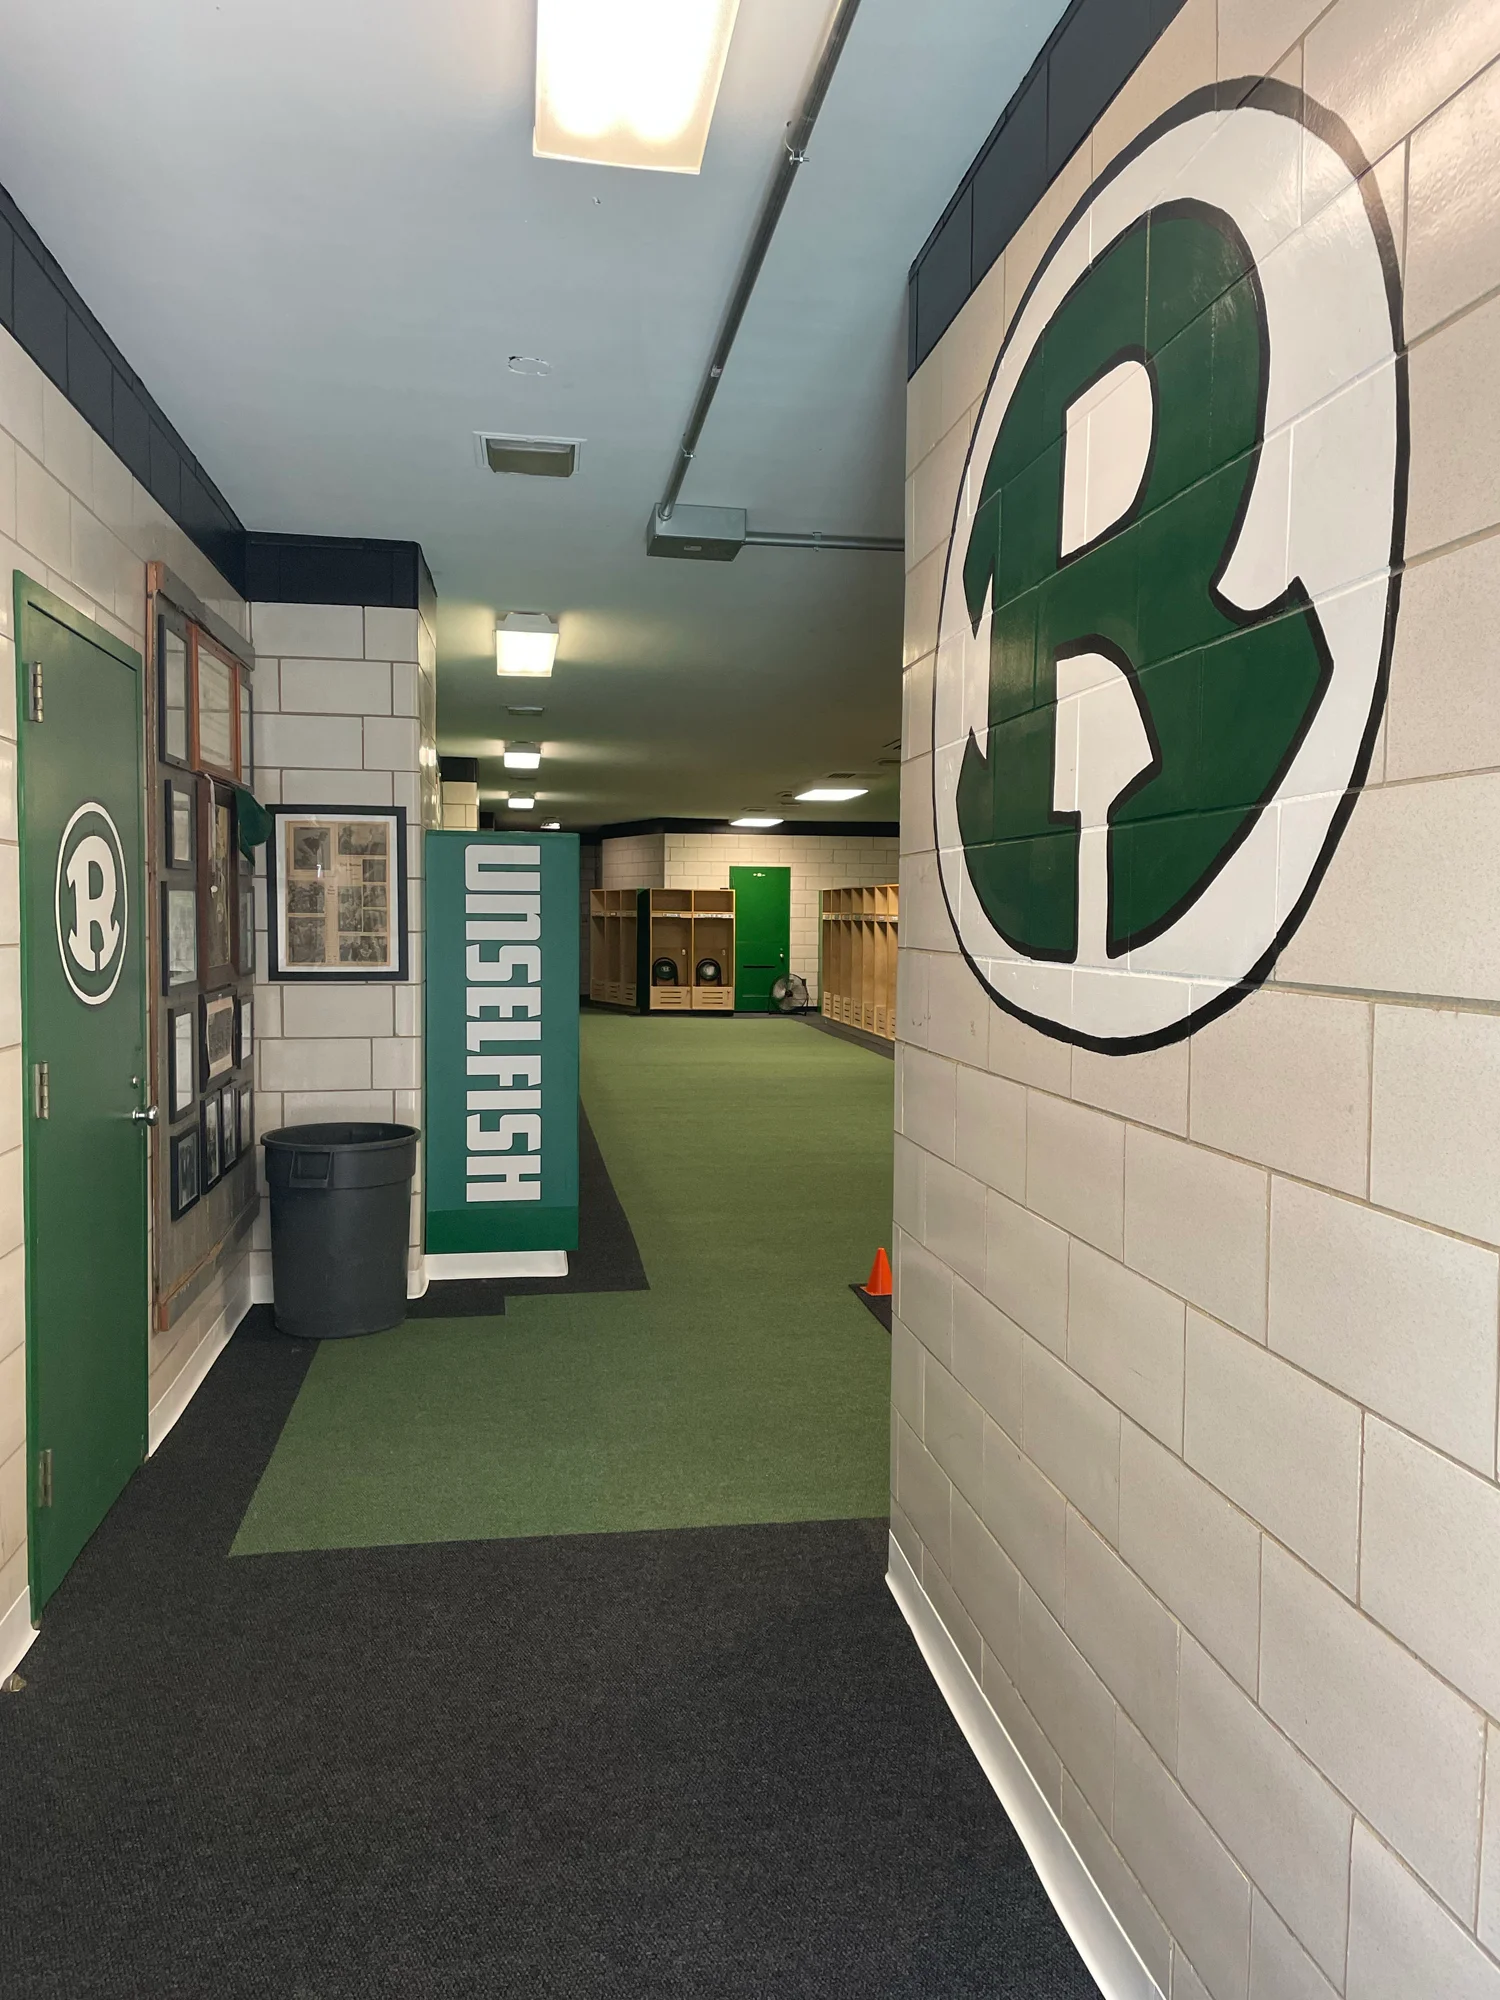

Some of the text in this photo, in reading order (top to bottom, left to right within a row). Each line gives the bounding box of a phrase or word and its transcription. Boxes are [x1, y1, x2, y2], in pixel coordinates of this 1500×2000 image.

[956, 197, 1334, 963] R
[66, 835, 121, 972] R
[465, 844, 542, 1202] UNSELFISH
